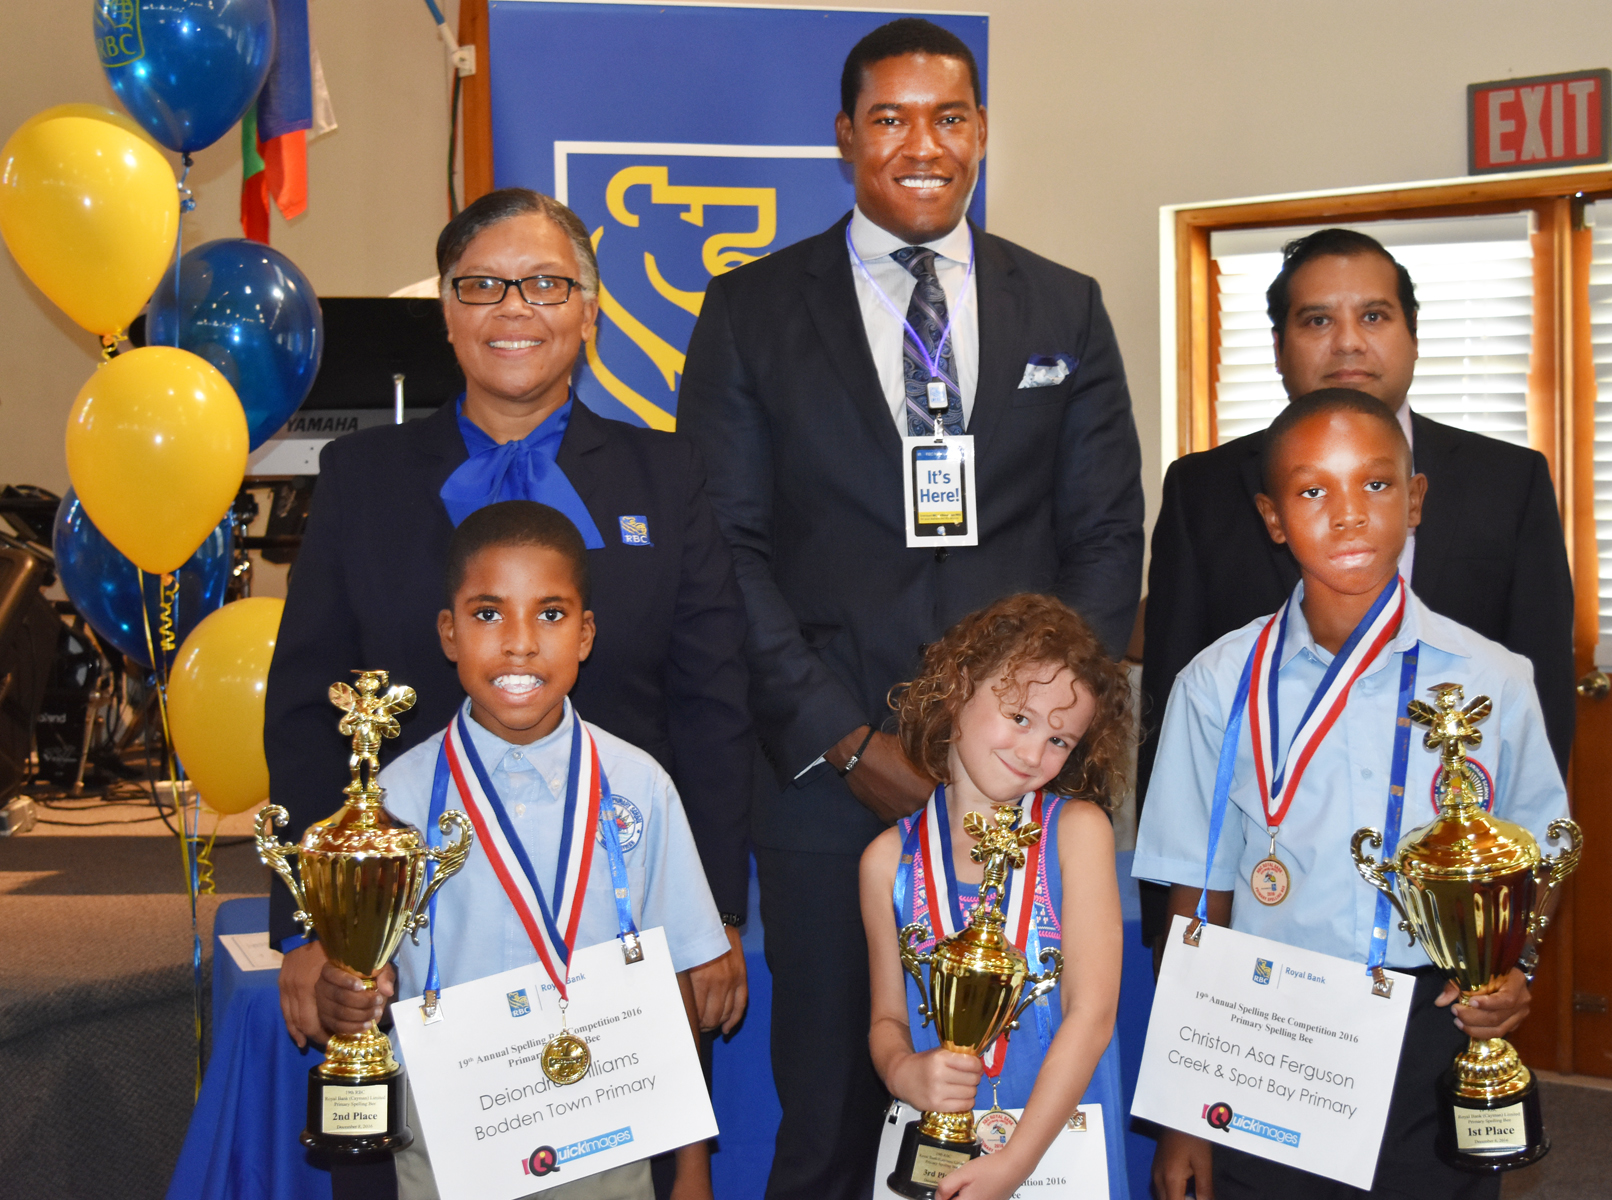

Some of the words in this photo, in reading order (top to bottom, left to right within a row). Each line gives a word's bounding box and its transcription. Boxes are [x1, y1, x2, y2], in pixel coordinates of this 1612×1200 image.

[1488, 80, 1595, 164] EXIT
[287, 417, 359, 432] YAMAHA
[920, 488, 960, 503] Here!
[625, 535, 648, 544] RBC
[1253, 975, 1269, 985] RBC
[1285, 966, 1306, 979] Royal
[1307, 972, 1326, 985] Bank
[512, 1006, 531, 1017] RBC
[621, 1006, 642, 1020] 2016
[1195, 990, 1209, 1000] 19th
[1209, 995, 1237, 1010] Annual
[1238, 1002, 1270, 1021] Spelling
[1271, 1012, 1286, 1024] Bee
[1287, 1016, 1337, 1038] Competition
[1338, 1030, 1359, 1044] 2016
[1230, 1013, 1263, 1032] Primary
[1264, 1024, 1297, 1041] Spelling
[1298, 1032, 1314, 1044] Bee
[584, 1032, 601, 1046] Bee
[457, 1056, 475, 1070] 19th
[476, 1047, 509, 1065] Annual
[510, 1036, 547, 1055] Spelling
[508, 1052, 543, 1068] Primar
[1179, 1025, 1241, 1057] Christon
[1244, 1045, 1276, 1067] Asa
[1279, 1053, 1355, 1090] Ferguson
[1168, 1049, 1211, 1075] Creek
[1213, 1064, 1225, 1079] &
[1228, 1066, 1264, 1088] Spot
[1266, 1078, 1297, 1102] Bay
[1299, 1087, 1358, 1120] Primary
[479, 1076, 563, 1111] Deiondr
[474, 1110, 544, 1141] Bodden
[546, 1095, 593, 1118] Town
[595, 1075, 656, 1104] Primary
[332, 1112, 350, 1121] 2nd
[353, 1111, 378, 1120] Place
[1468, 1127, 1482, 1137] 1st
[1485, 1126, 1515, 1136] Place
[923, 1168, 936, 1178] 3rd
[1046, 1177, 1067, 1186] 2016
